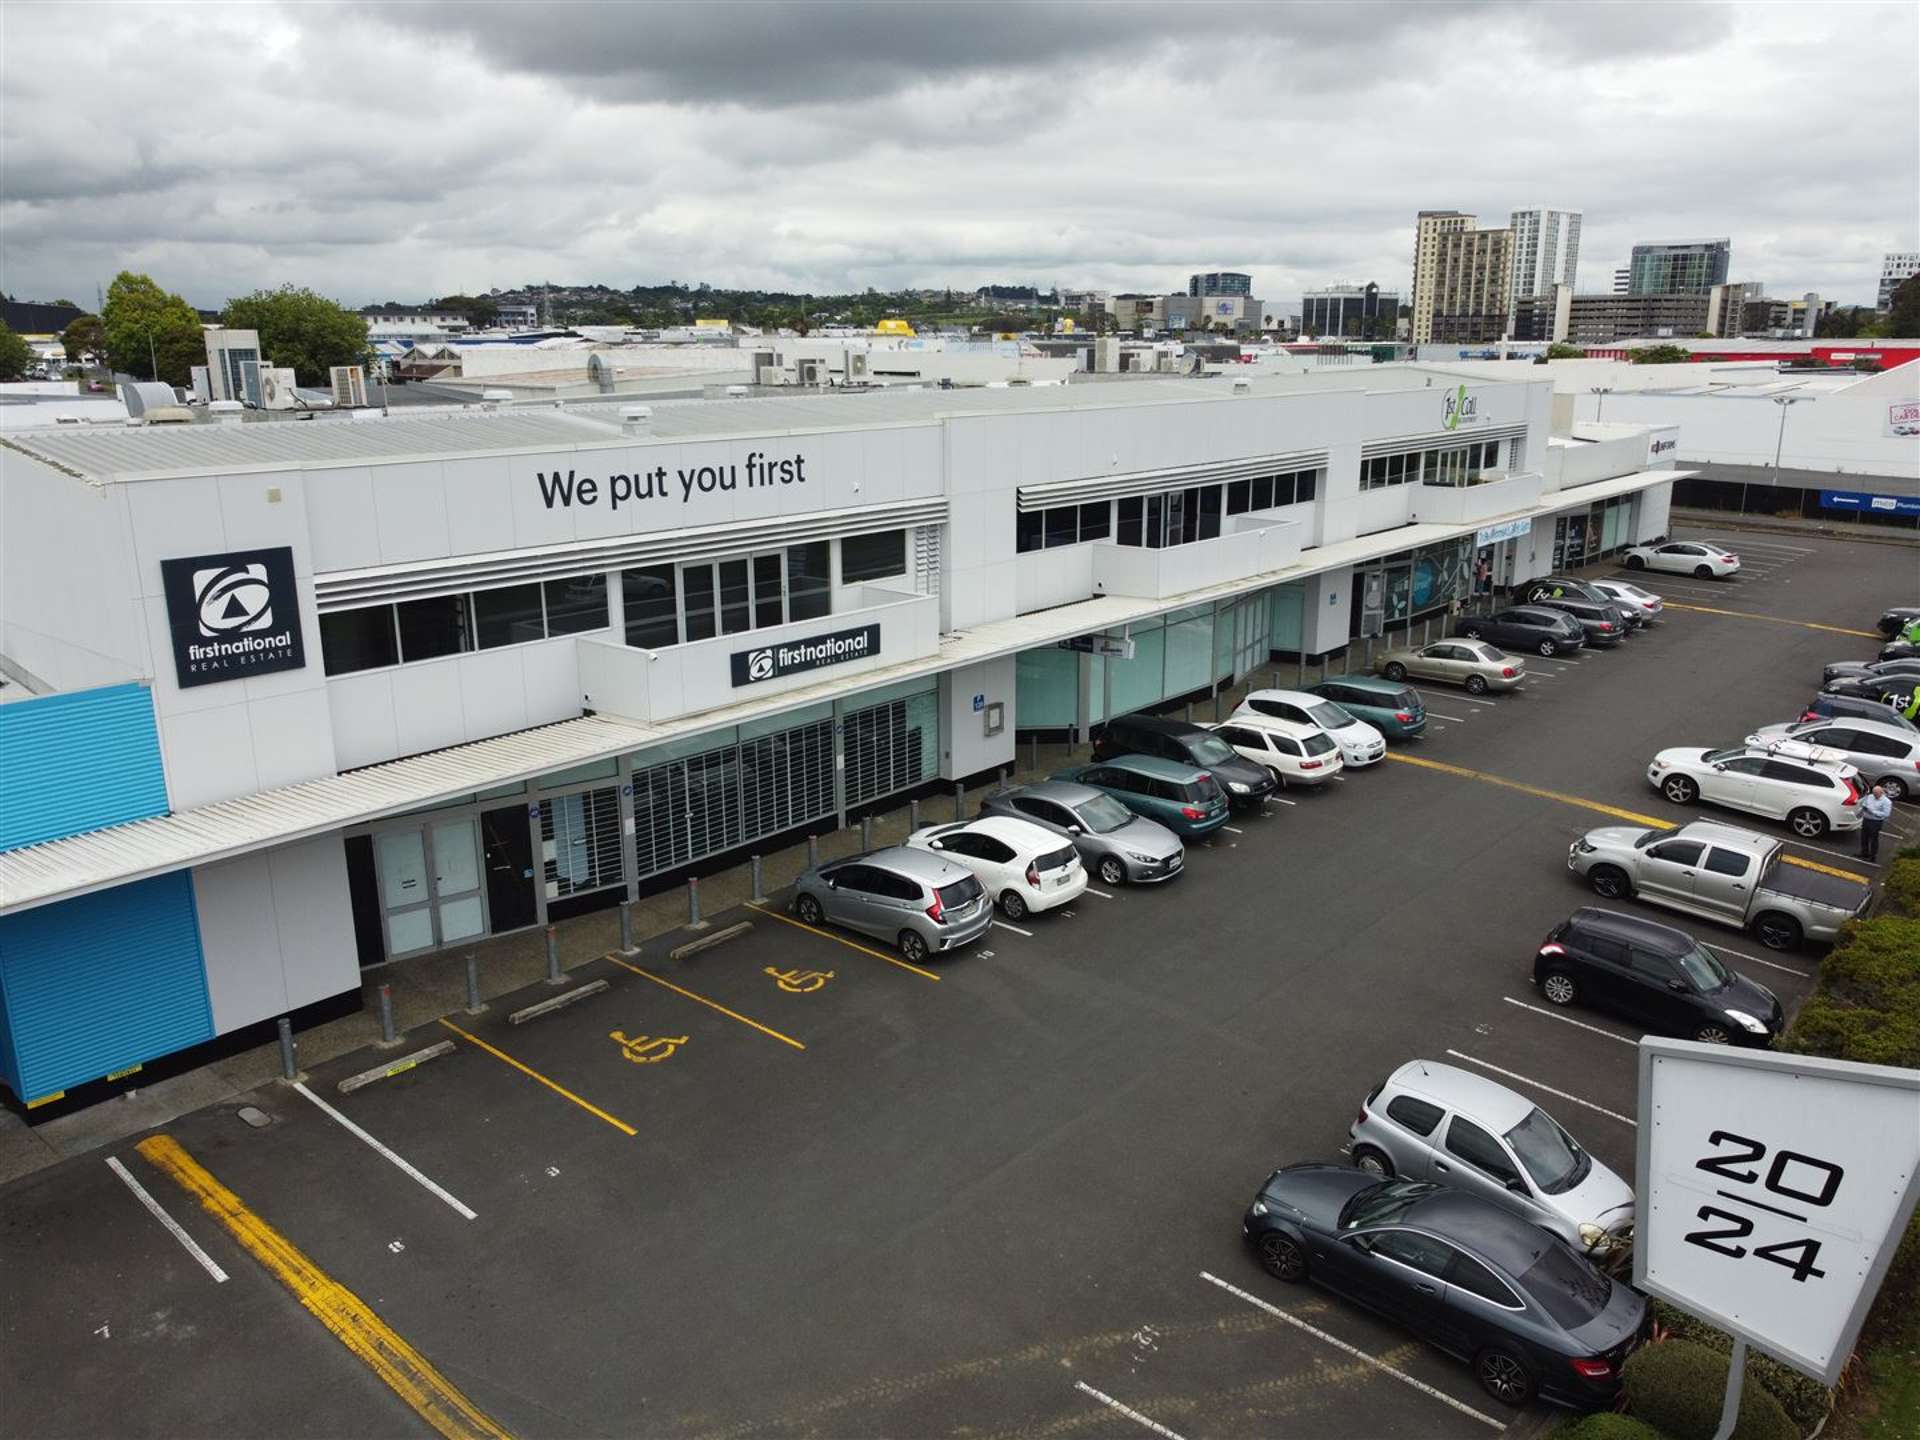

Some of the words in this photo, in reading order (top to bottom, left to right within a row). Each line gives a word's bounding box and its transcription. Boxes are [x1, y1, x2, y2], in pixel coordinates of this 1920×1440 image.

[537, 470, 598, 509] We
[609, 467, 668, 510] put
[677, 465, 736, 503] you
[745, 453, 805, 488] first
[189, 631, 291, 660] firstnational
[190, 660, 228, 673] REAL
[240, 649, 292, 665] ESTATE
[779, 631, 868, 667] firstnational
[816, 656, 835, 666] REAL
[841, 650, 868, 661] ESTATE
[1889, 693, 1911, 712] 1st
[1696, 1130, 1844, 1207] 20
[1684, 1205, 1825, 1283] 24
